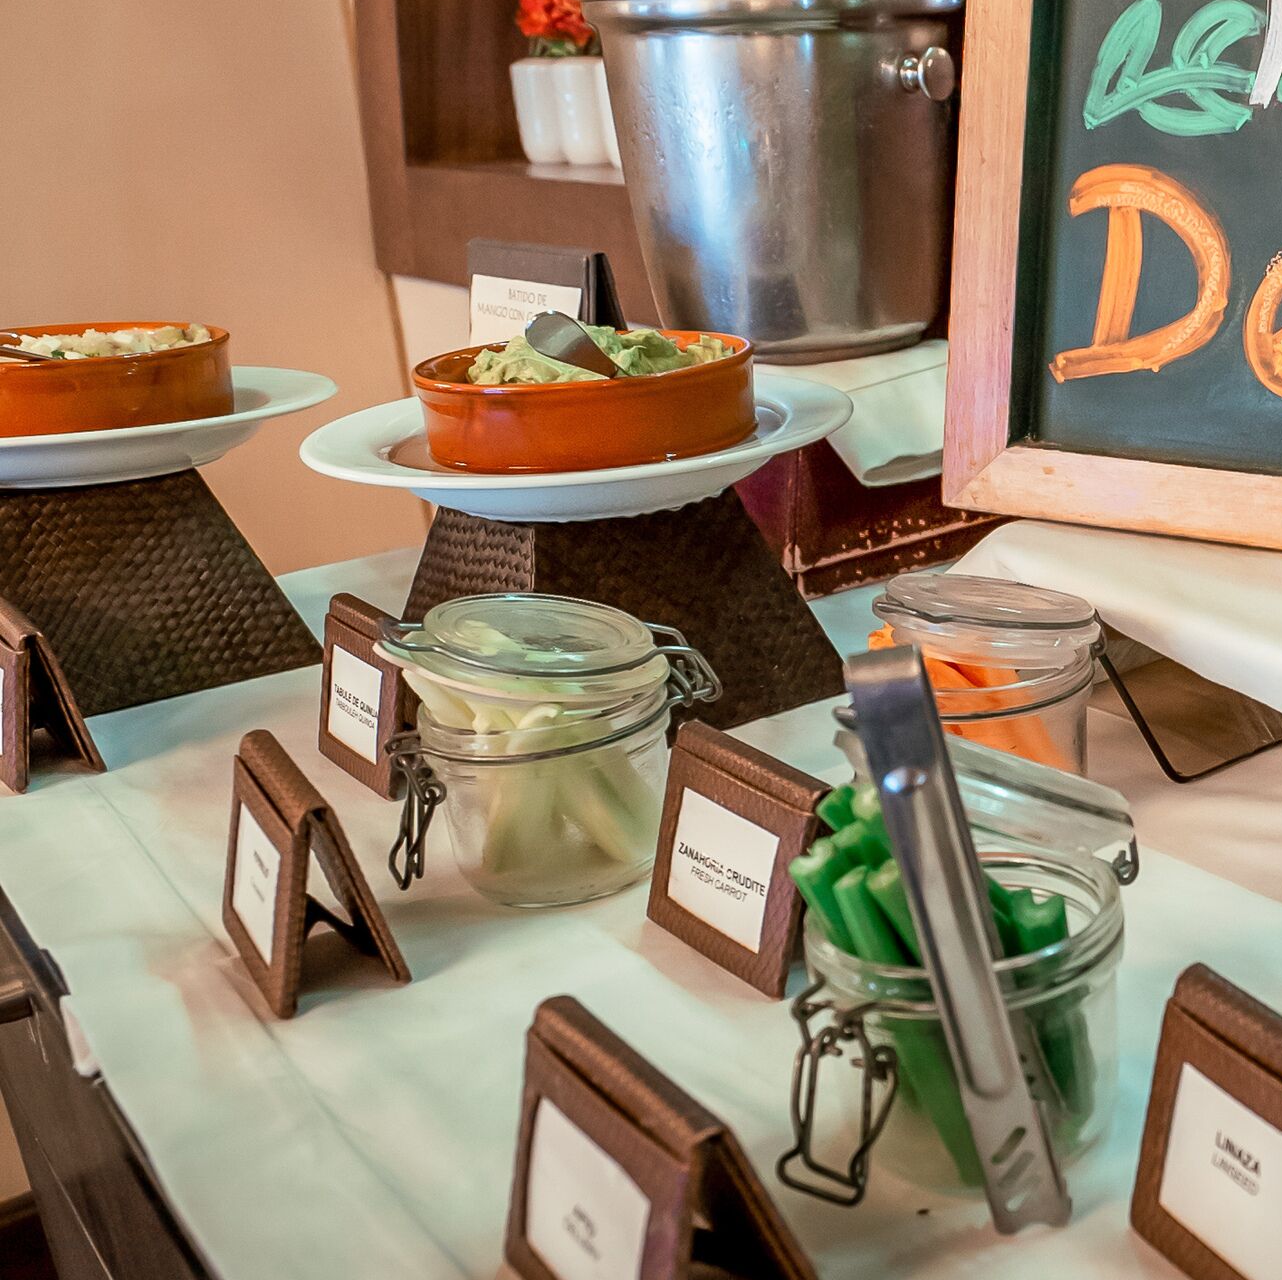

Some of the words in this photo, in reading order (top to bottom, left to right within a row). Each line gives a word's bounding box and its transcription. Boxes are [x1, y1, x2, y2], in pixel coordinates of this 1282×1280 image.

[537, 293, 547, 307] DE
[352, 695, 360, 708] DE
[678, 842, 724, 876] ZANAHORIA
[726, 868, 766, 897] CRUDITE
[690, 865, 714, 885] FRESH
[714, 879, 748, 902] CARROT
